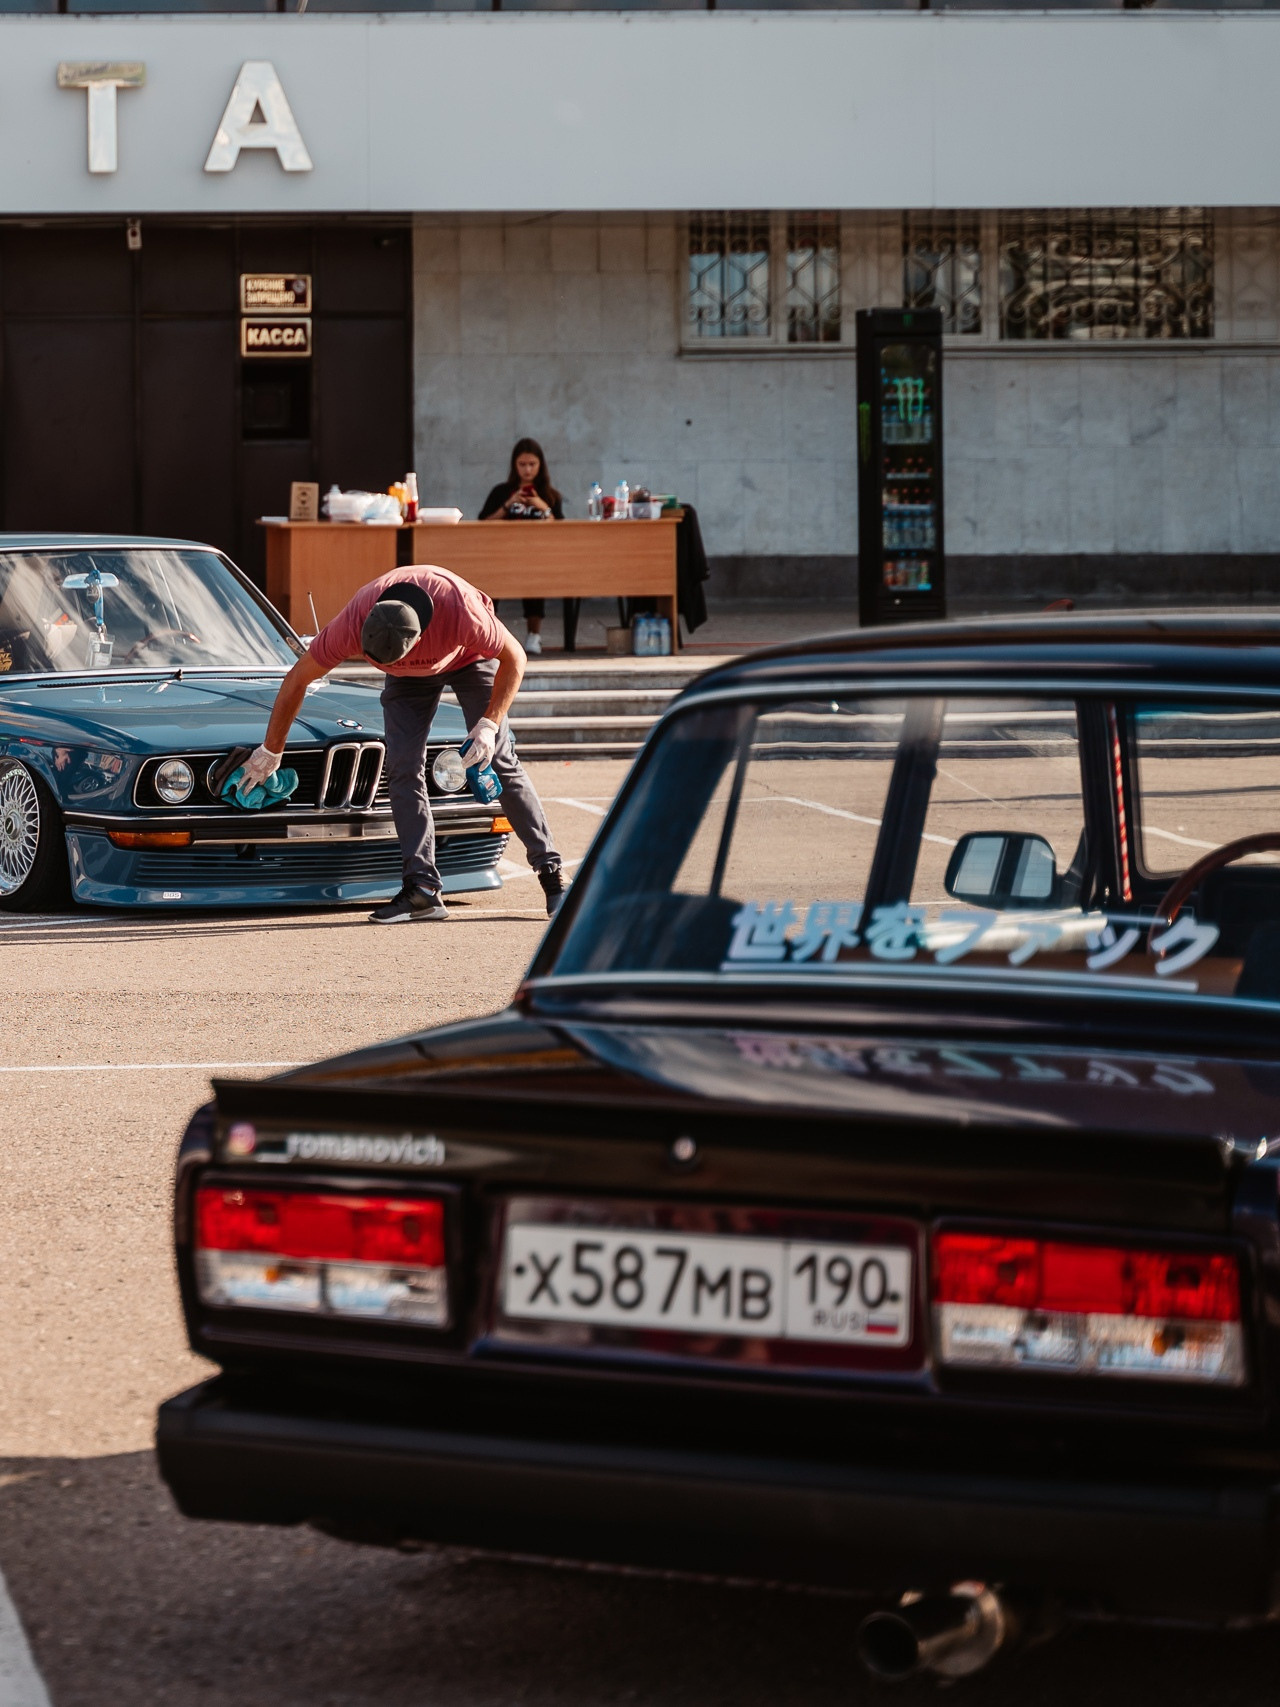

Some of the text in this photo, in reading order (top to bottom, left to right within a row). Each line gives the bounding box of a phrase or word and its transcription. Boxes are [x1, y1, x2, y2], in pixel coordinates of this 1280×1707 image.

[247, 327, 306, 346] КАССА
[728, 901, 1220, 977] 世界をファック
[794, 1252, 889, 1311] 190
